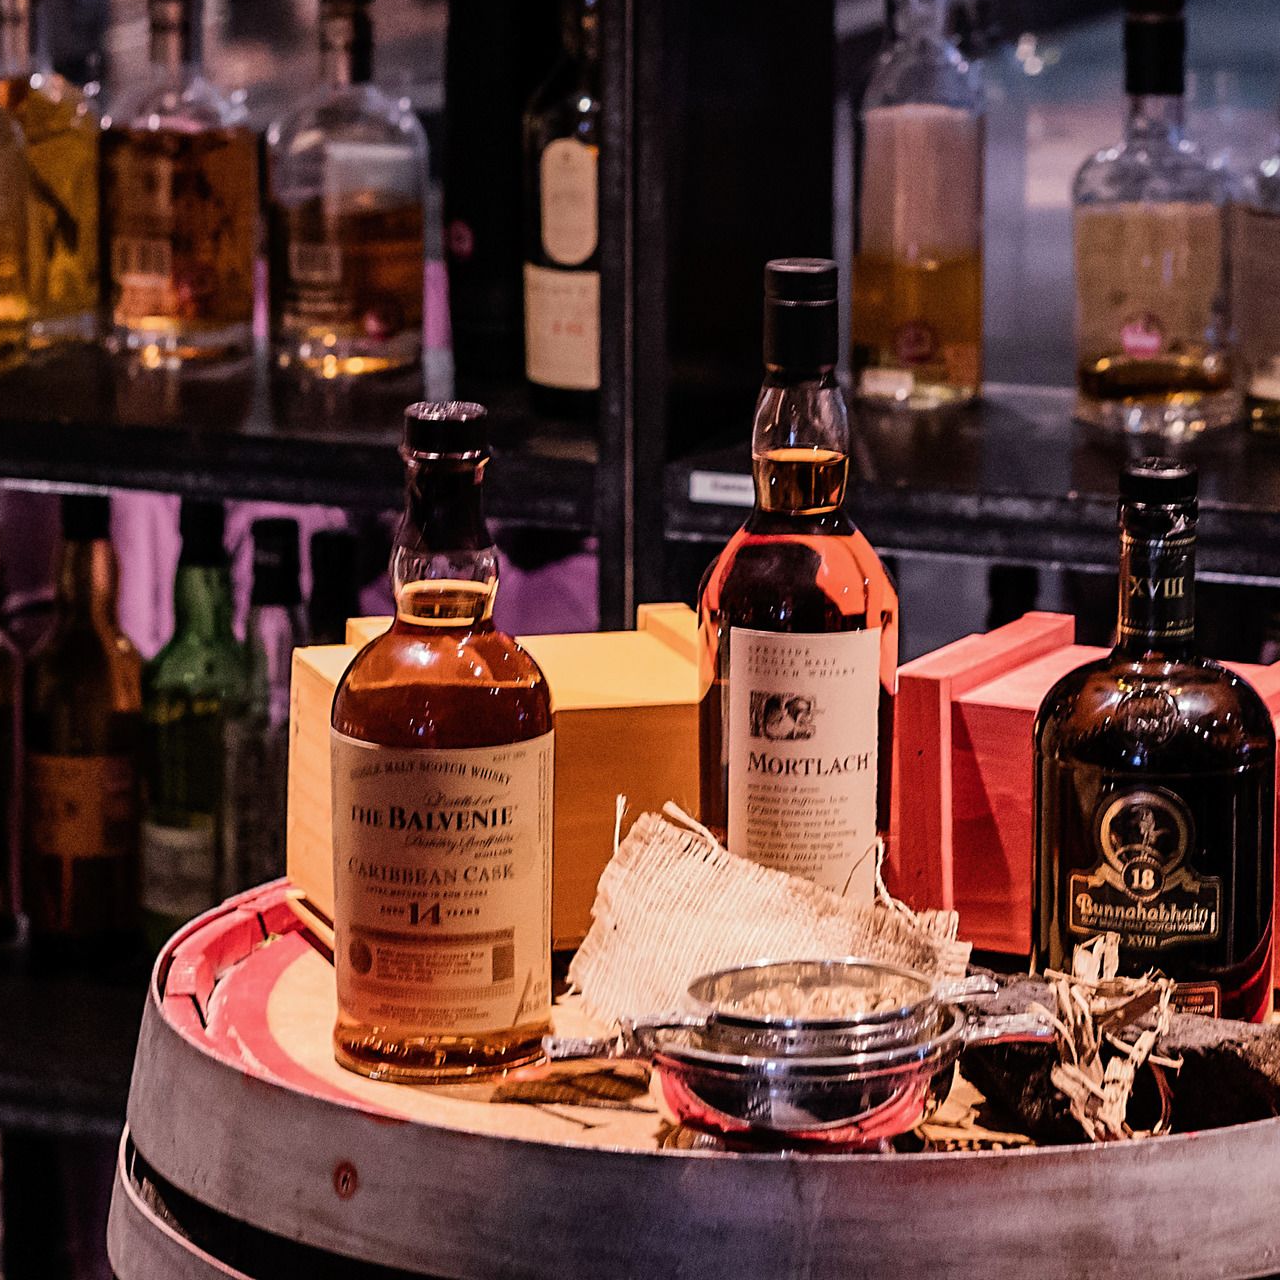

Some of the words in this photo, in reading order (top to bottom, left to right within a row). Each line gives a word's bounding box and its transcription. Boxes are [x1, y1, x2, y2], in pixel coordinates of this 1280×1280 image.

[1129, 576, 1186, 600] XVIII
[420, 760, 468, 777] SCOTCH
[470, 766, 512, 786] WHISKY
[748, 752, 869, 777] MORTLACH
[351, 805, 384, 827] THE
[389, 804, 513, 831] BALVENIE
[349, 857, 457, 885] CARIBBEAN
[463, 863, 515, 883] CASK
[1131, 869, 1155, 891] 18
[409, 902, 440, 926] 14
[1075, 892, 1209, 922] Bunnahabhain
[1127, 934, 1157, 948] XVIII
